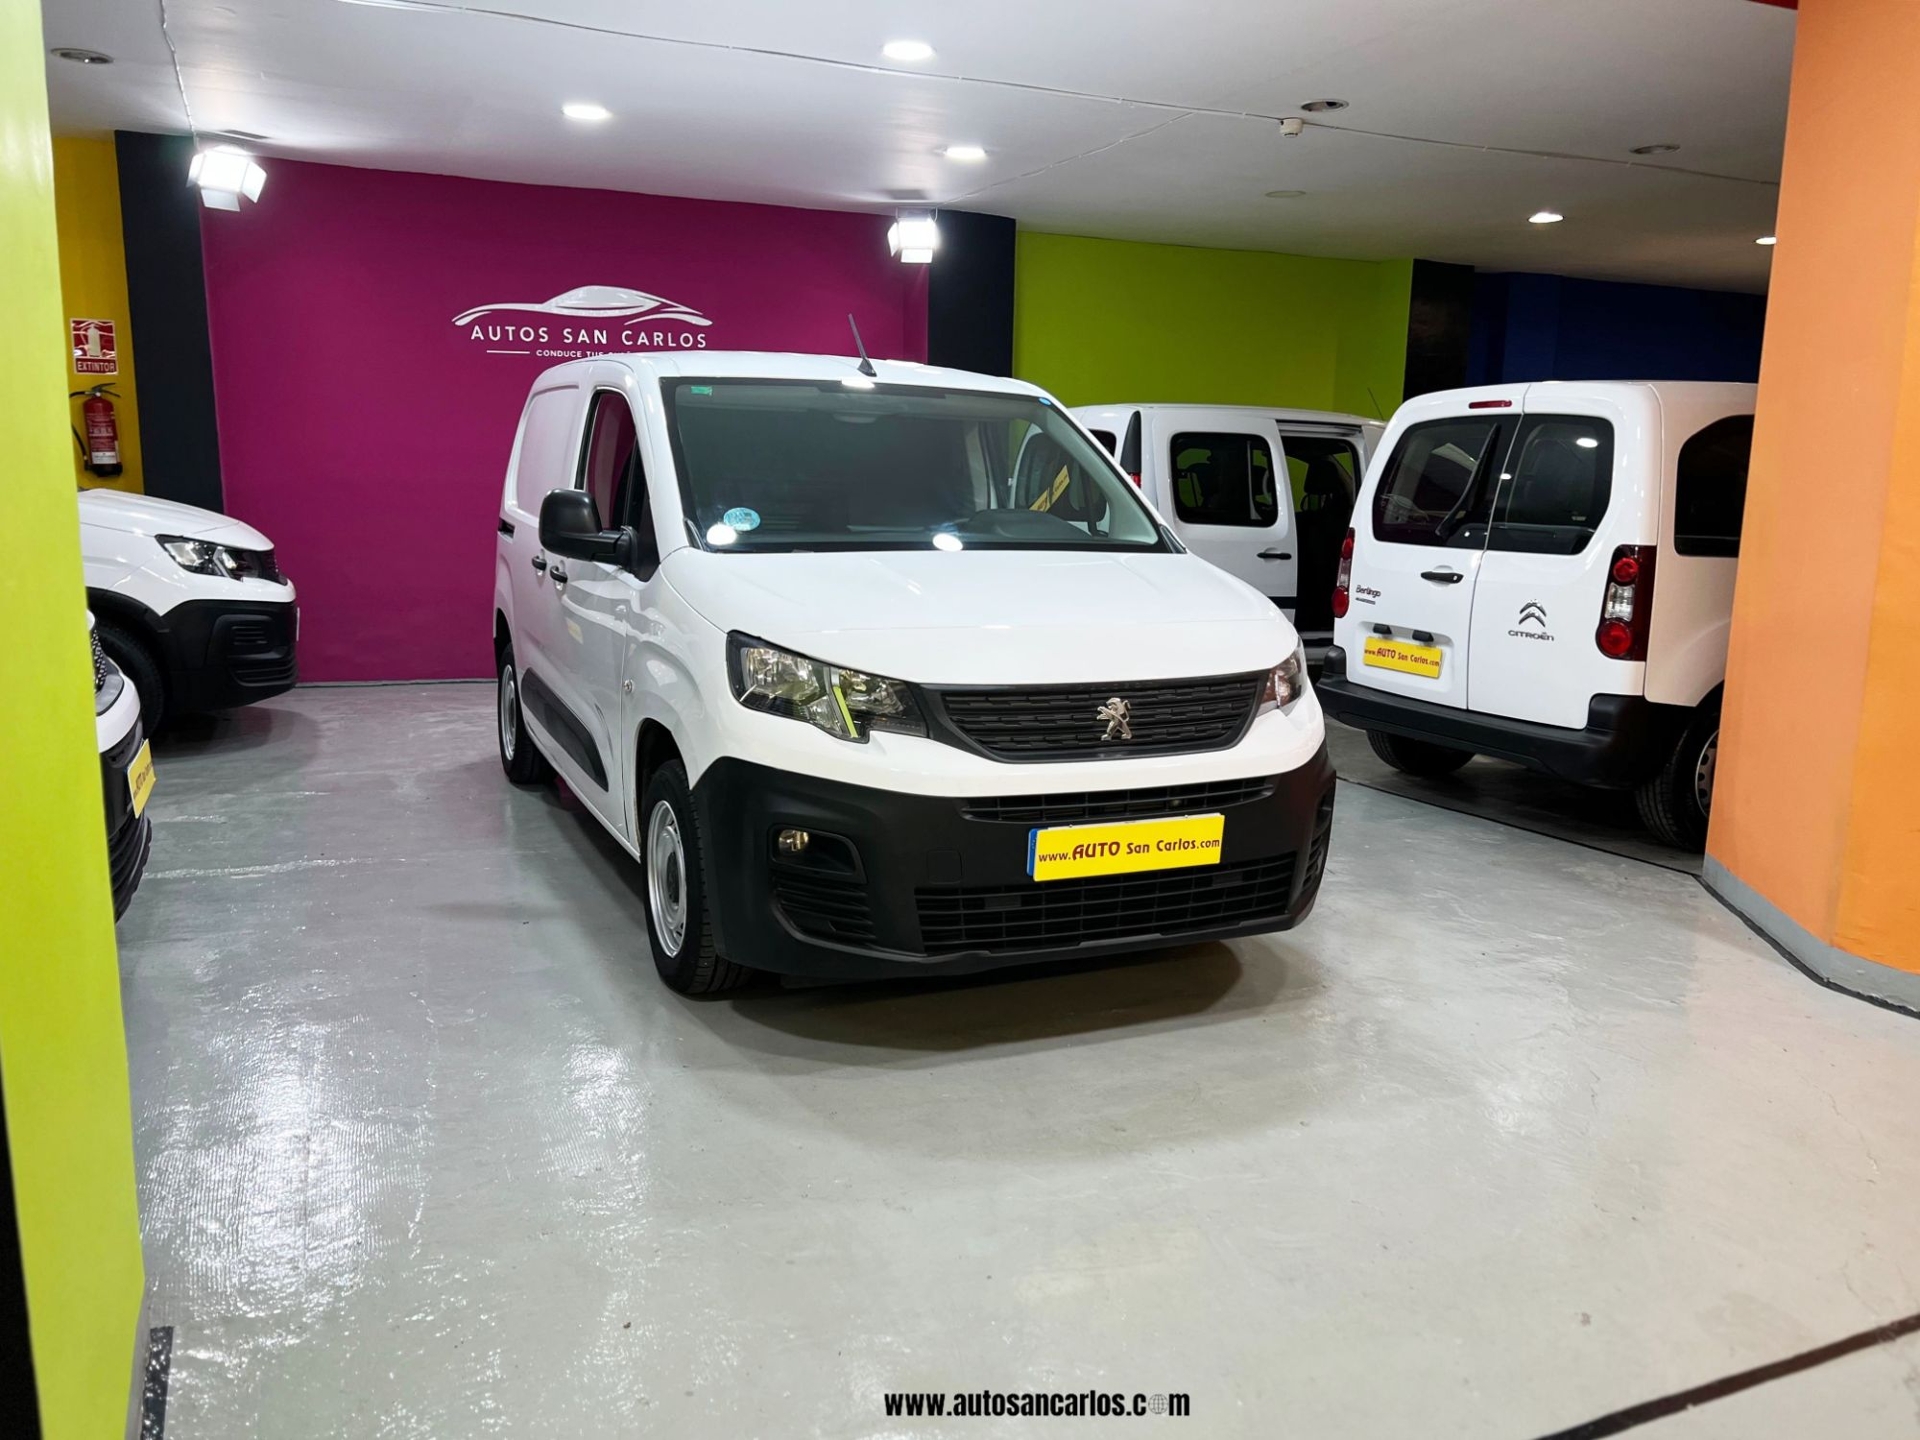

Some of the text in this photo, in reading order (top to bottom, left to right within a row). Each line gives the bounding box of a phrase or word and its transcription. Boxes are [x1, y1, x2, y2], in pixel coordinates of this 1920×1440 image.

[470, 325, 707, 348] AUTOS SAN CARLOS
[536, 349, 582, 358] CONDUCE
[77, 361, 115, 371] EXTINTOR
[1355, 584, 1382, 598] Berlingo
[1398, 652, 1408, 661] San
[1038, 838, 1220, 862] www.AUTO San Carlos.com
